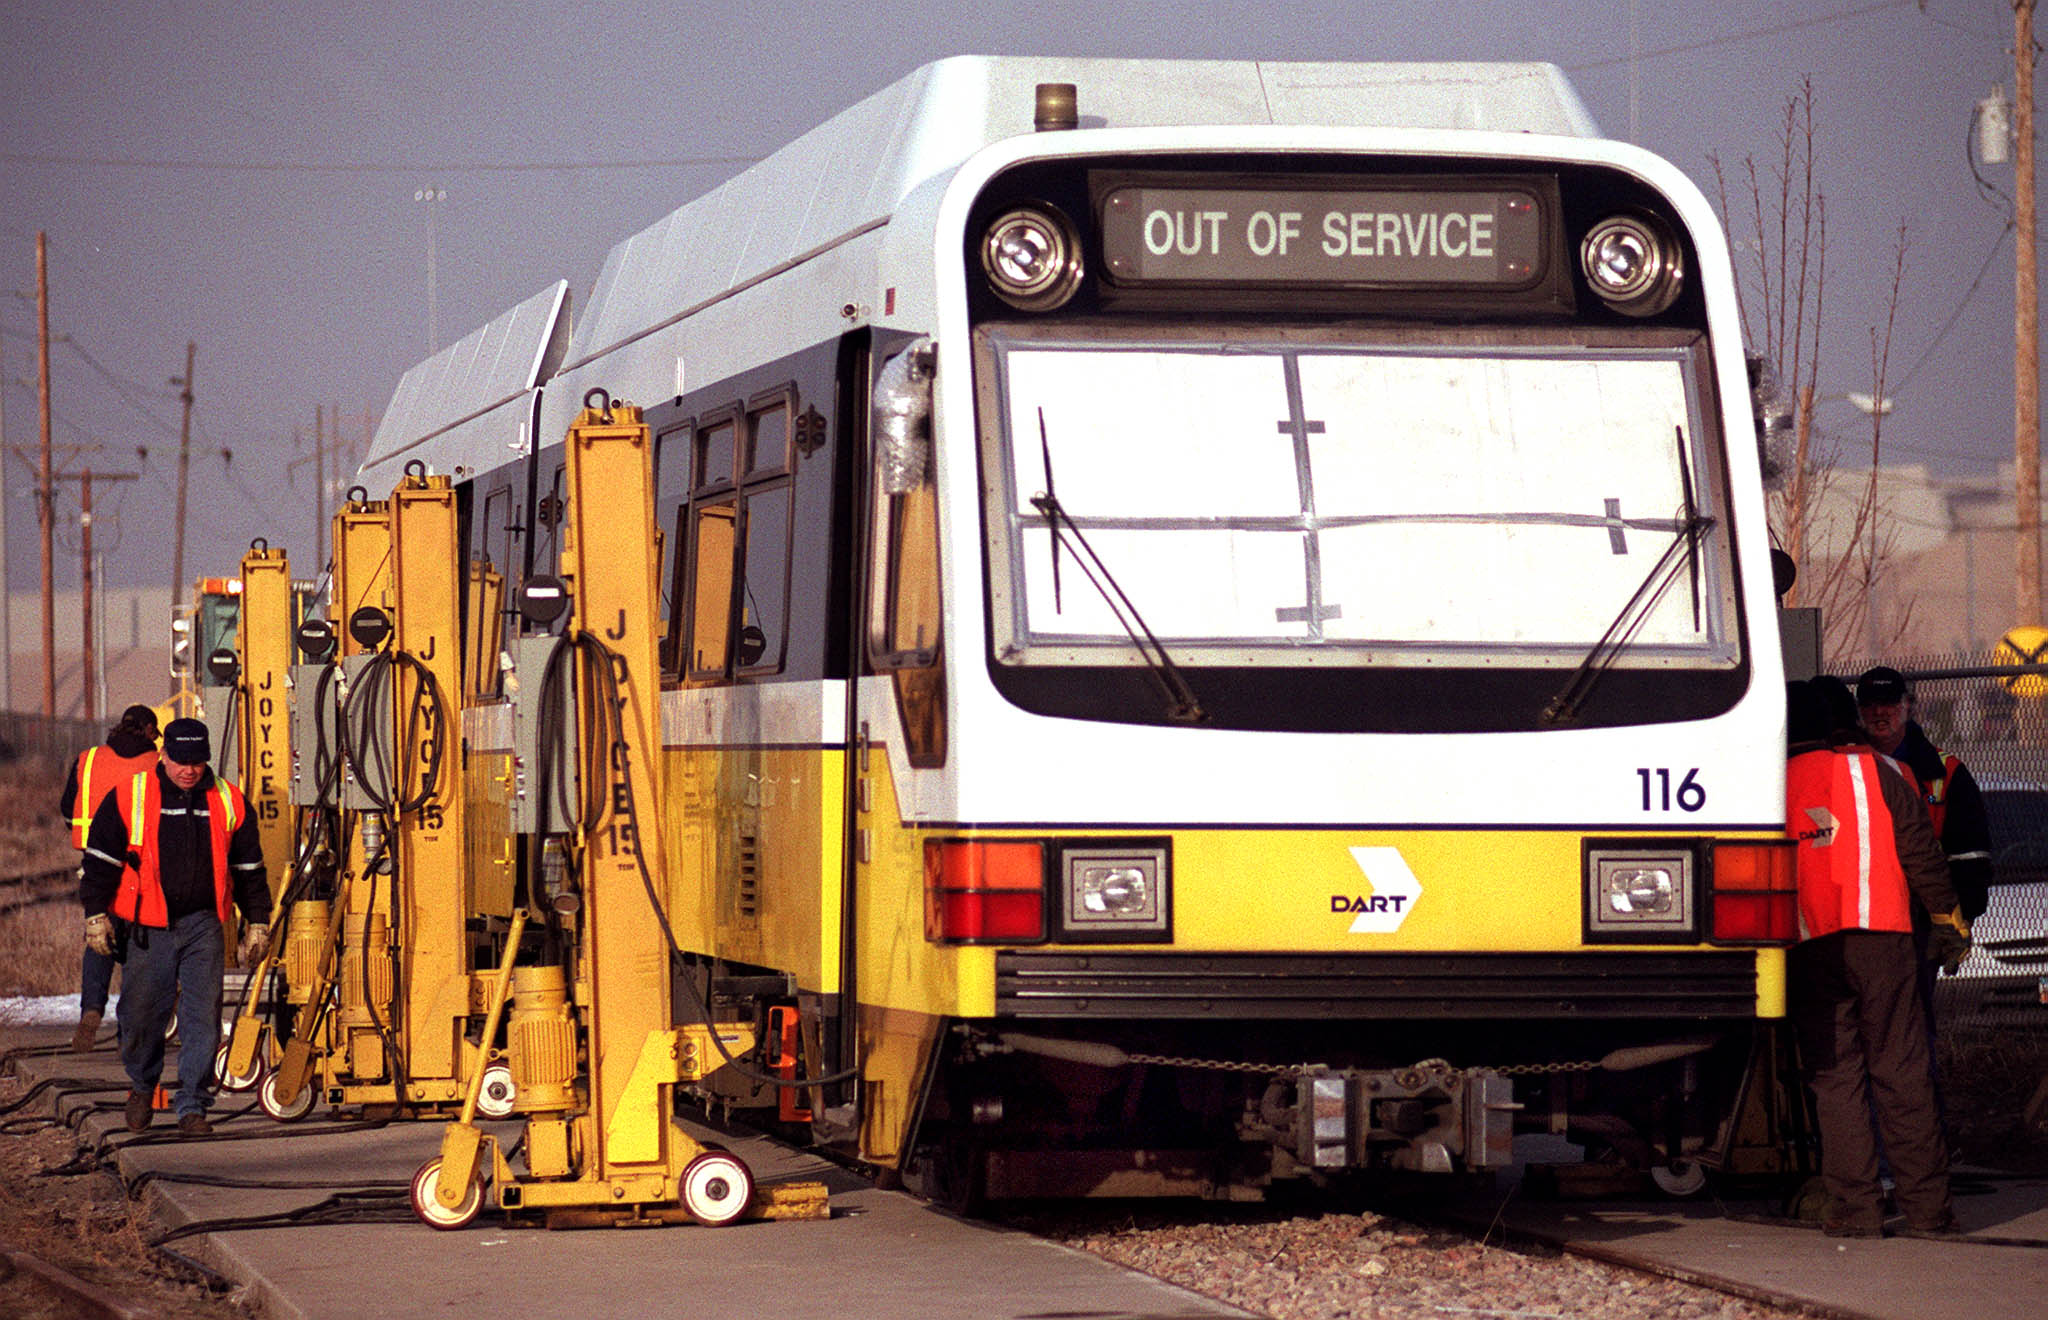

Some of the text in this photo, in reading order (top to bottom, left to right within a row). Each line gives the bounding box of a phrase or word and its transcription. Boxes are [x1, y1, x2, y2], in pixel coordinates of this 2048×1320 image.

[1144, 209, 1494, 258] OUT OF SERVICE
[259, 671, 275, 796] JOYCE
[1636, 767, 1706, 812] 116
[259, 800, 279, 820] 15
[418, 804, 444, 830] 15
[609, 823, 638, 856] 15
[1799, 826, 1834, 840] DART
[1331, 895, 1407, 912] DART
